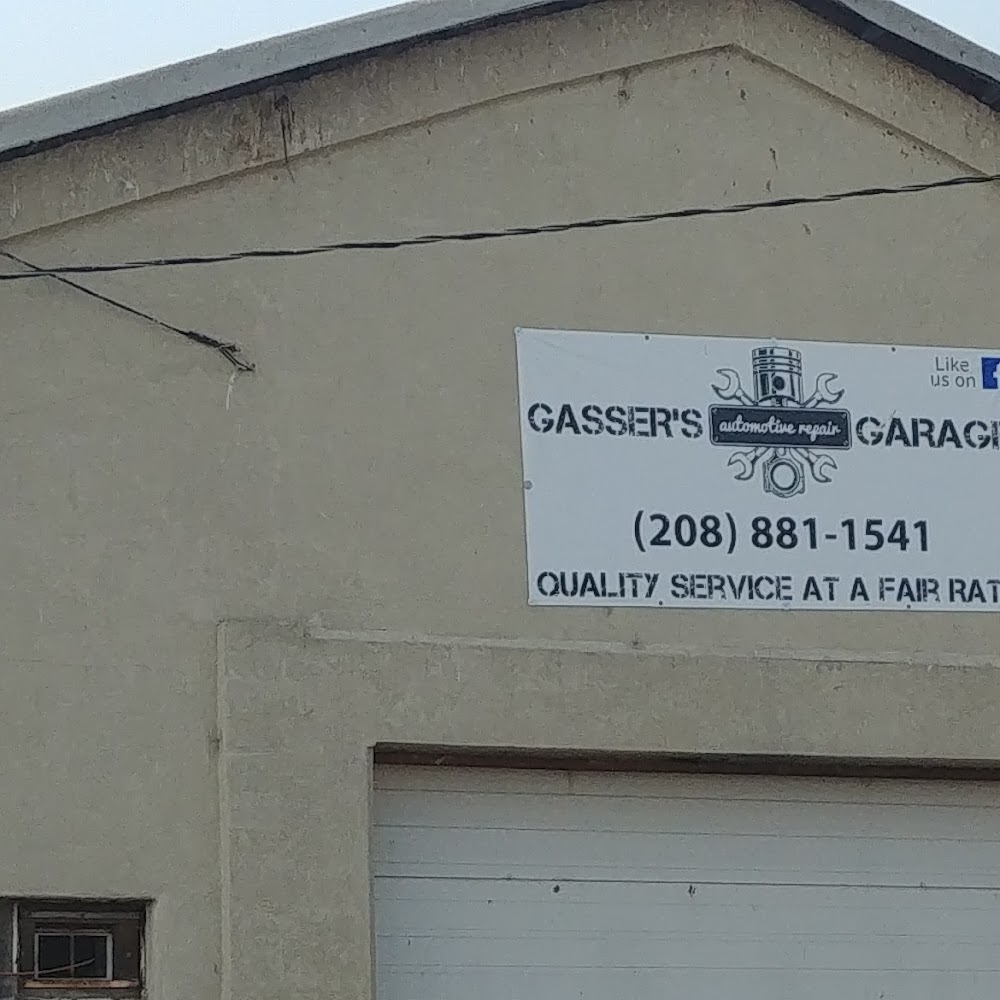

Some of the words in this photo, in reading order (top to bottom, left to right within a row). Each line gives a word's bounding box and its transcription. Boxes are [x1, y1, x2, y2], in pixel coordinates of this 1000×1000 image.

[936, 356, 969, 373] Like
[931, 373, 950, 388] us
[955, 375, 976, 389] on
[527, 403, 704, 439] GASSER'S
[719, 418, 797, 436] automotive
[798, 421, 842, 439] repair
[634, 510, 738, 554] (208)
[751, 516, 930, 552] 881-1541
[537, 571, 660, 602] QUALITY
[671, 574, 792, 602] SERVICE
[803, 576, 839, 602] AT
[850, 576, 870, 602] A
[880, 576, 940, 604] FAIR
